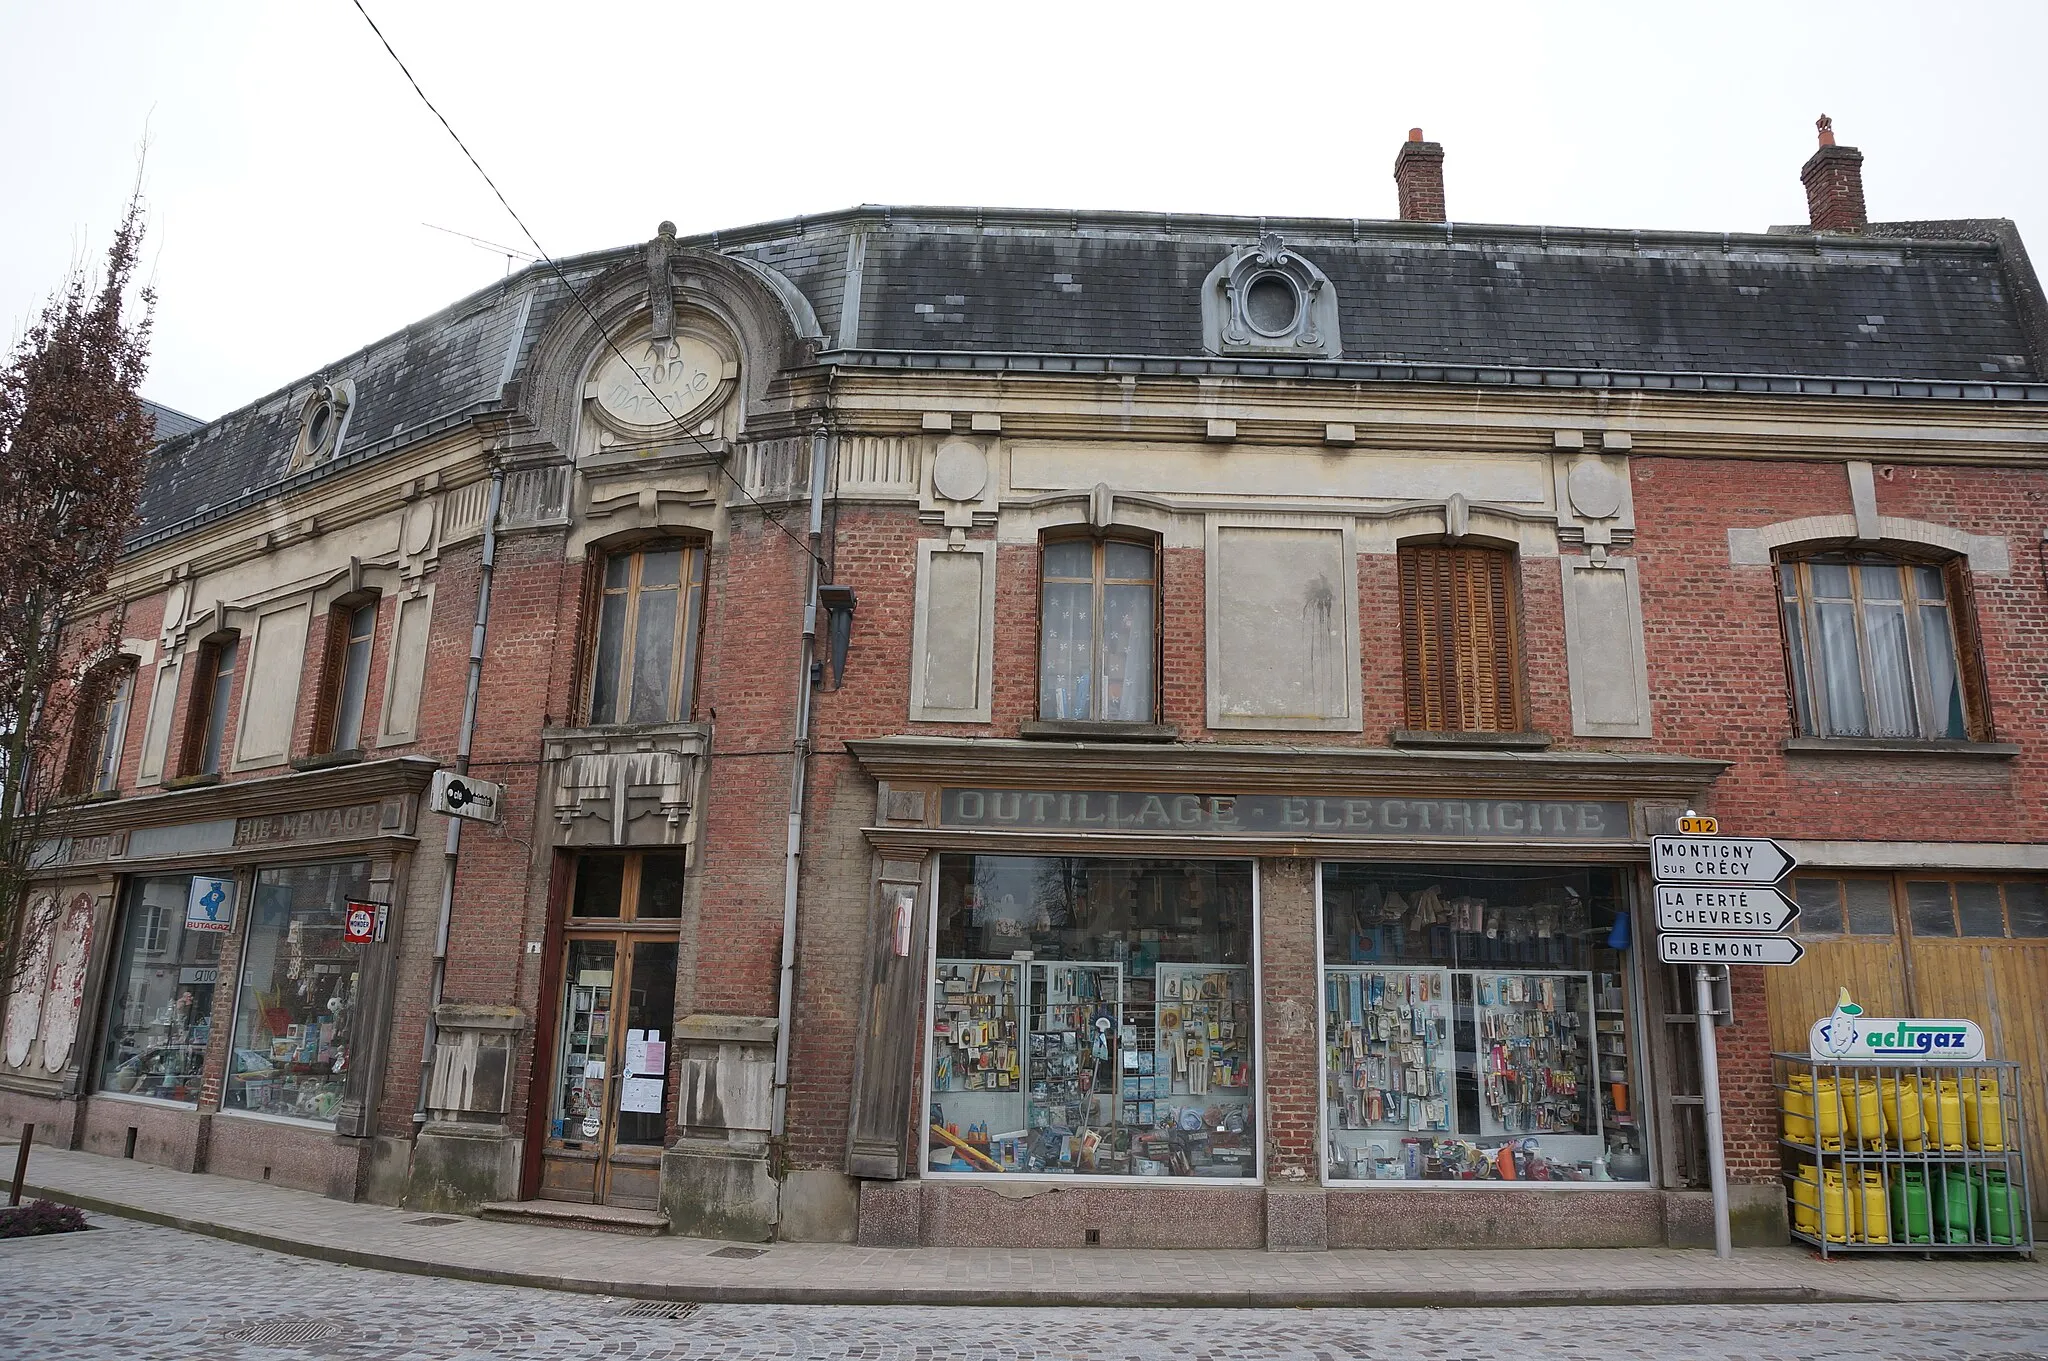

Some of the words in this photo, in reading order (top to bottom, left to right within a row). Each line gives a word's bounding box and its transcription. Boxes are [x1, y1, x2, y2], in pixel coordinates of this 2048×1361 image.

[957, 790, 1239, 826] OUTILLAGE
[1682, 820, 1690, 831] D
[1695, 820, 1714, 832] 12
[1661, 843, 1754, 859] MONTIGNY
[1663, 865, 1686, 874] SUR
[1695, 860, 1750, 875] CRÉCY
[1665, 892, 1685, 906] LA
[1695, 891, 1749, 908] FERTÉ
[350, 920, 370, 928] WONDER
[354, 913, 367, 921] PILE
[1666, 910, 1773, 925] -CHEVRESIS
[186, 921, 230, 931] BUTAGAZ
[1669, 941, 1763, 957] RIBEMONT
[1866, 1021, 1967, 1054] actigaz
